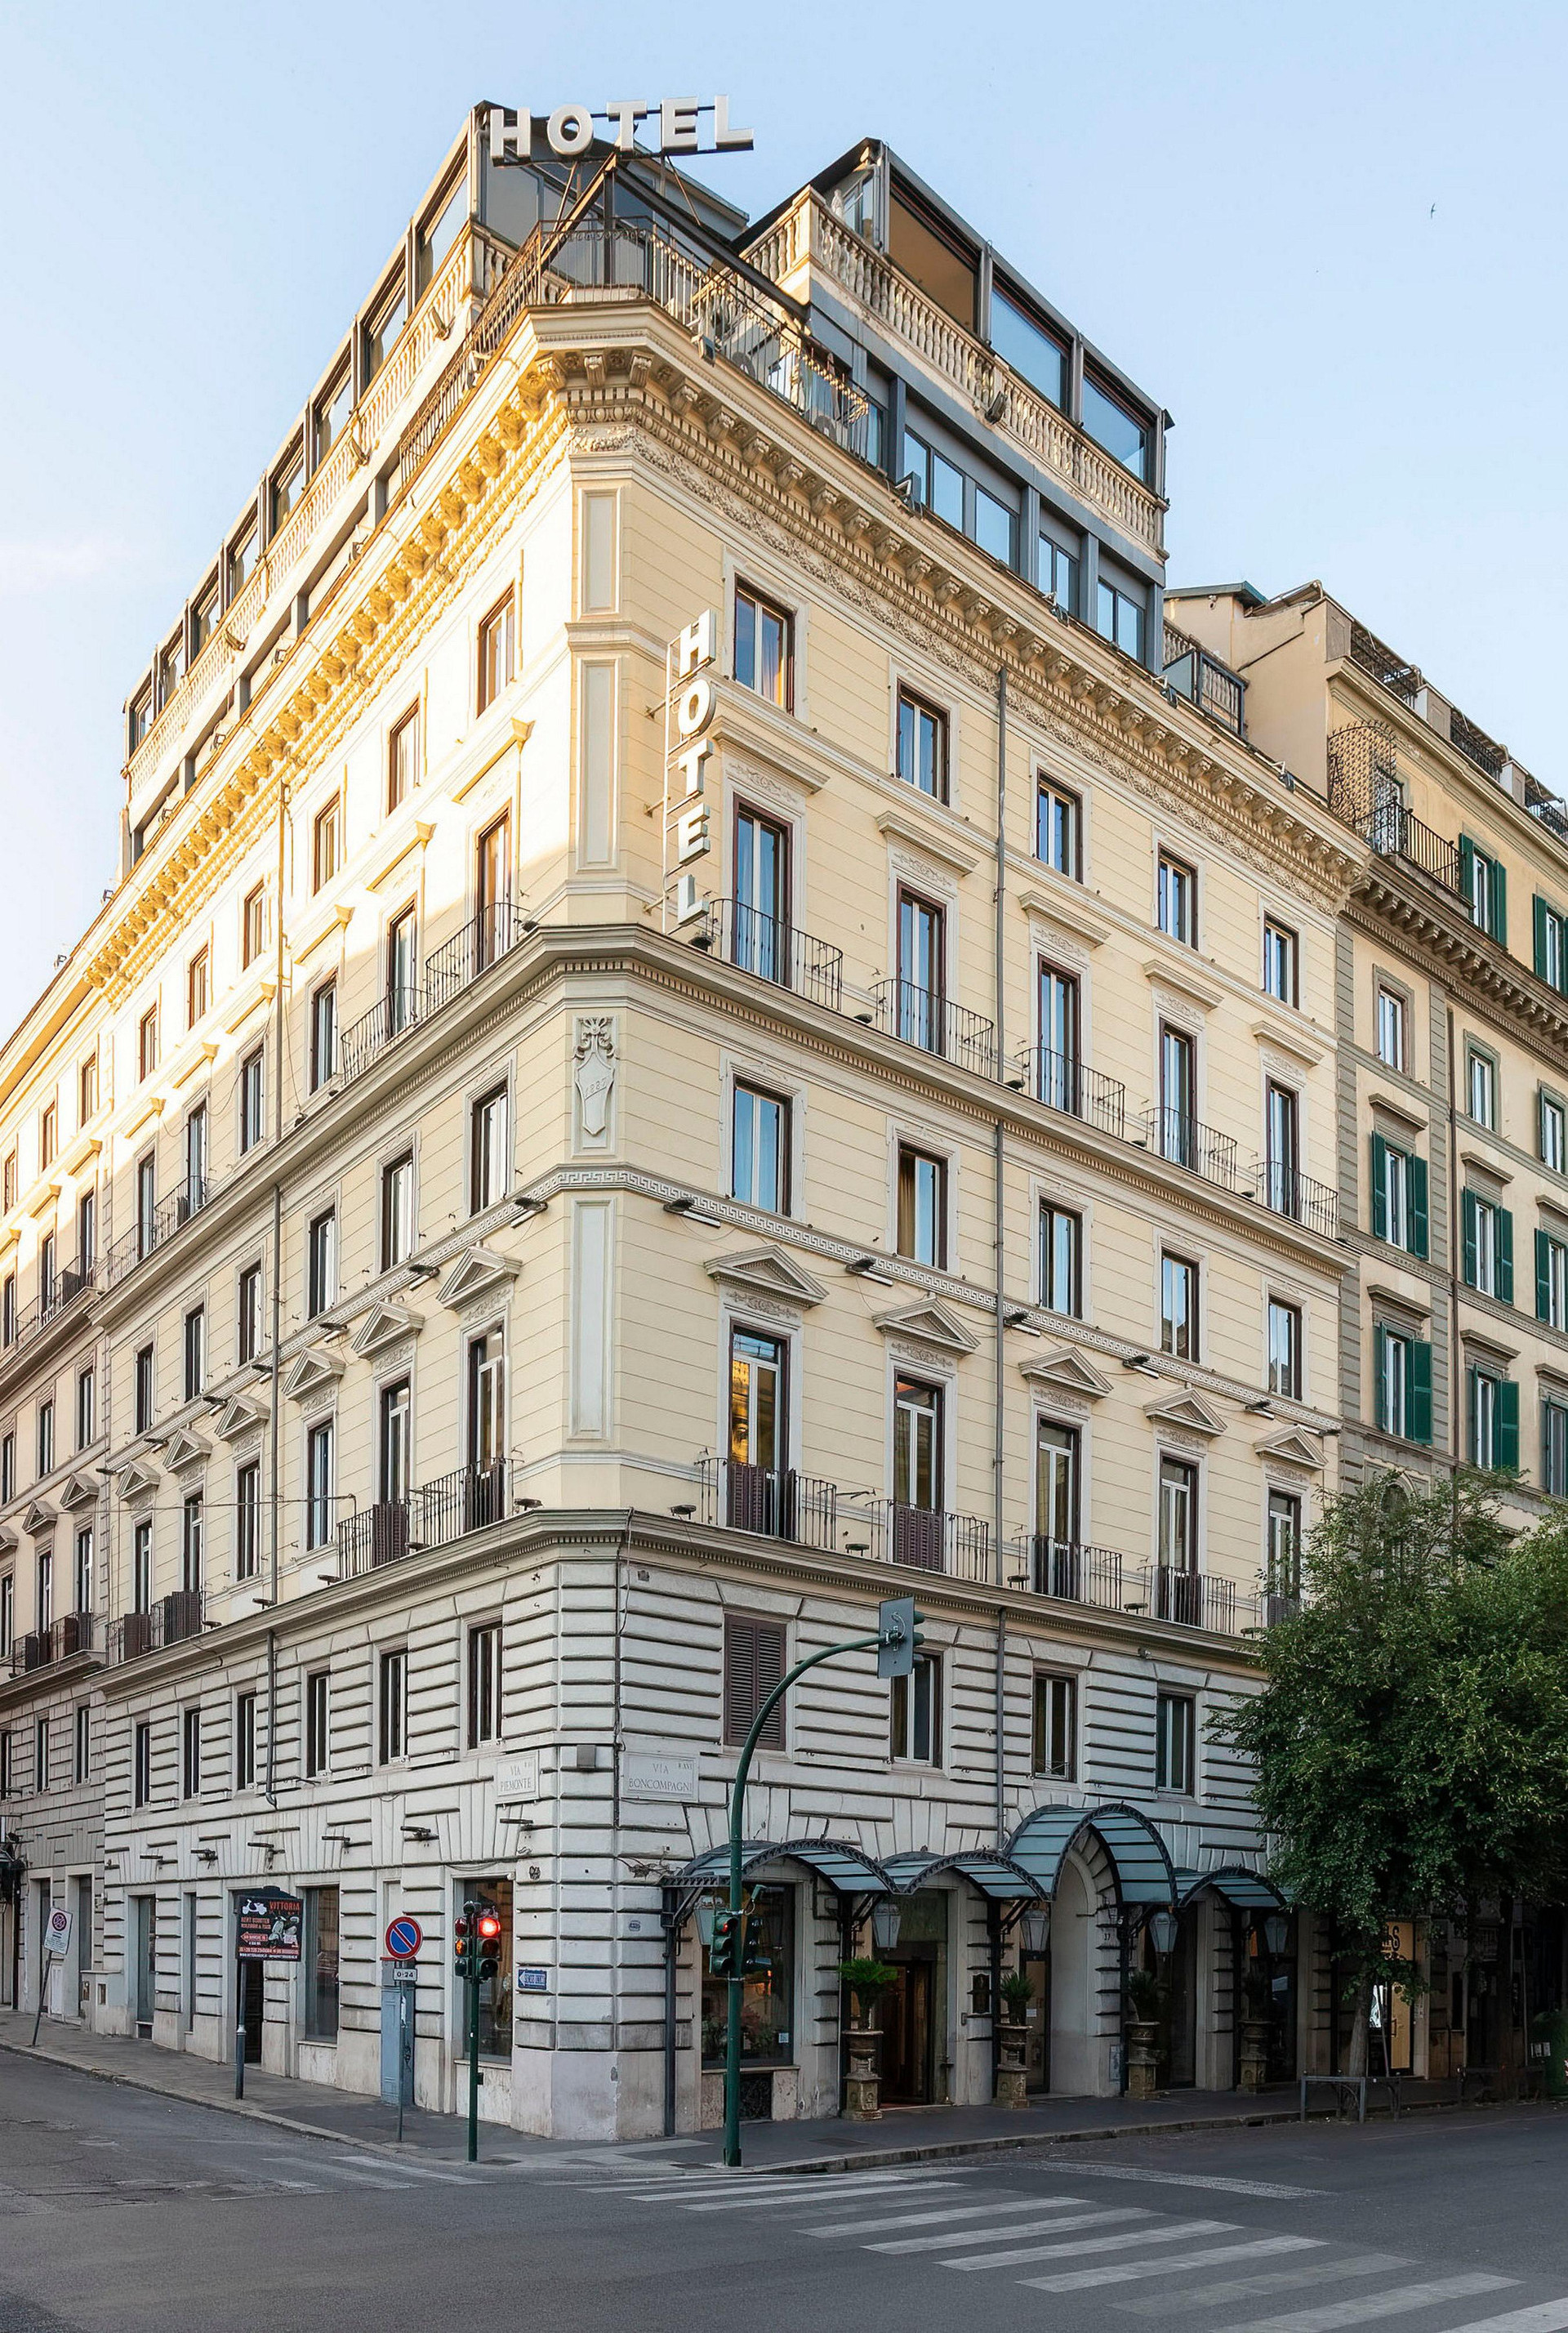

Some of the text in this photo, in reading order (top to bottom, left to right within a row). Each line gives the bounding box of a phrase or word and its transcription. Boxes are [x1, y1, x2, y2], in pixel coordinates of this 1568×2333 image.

[490, 94, 754, 166] HOTEL
[677, 608, 716, 927] HOTEL
[510, 1764, 521, 1776] VIA
[653, 1763, 670, 1774] VIA
[500, 1777, 532, 1792] PIEMONTE
[628, 1778, 693, 1792] BONCOMPAGNI
[269, 1901, 301, 1911] VITTORIA
